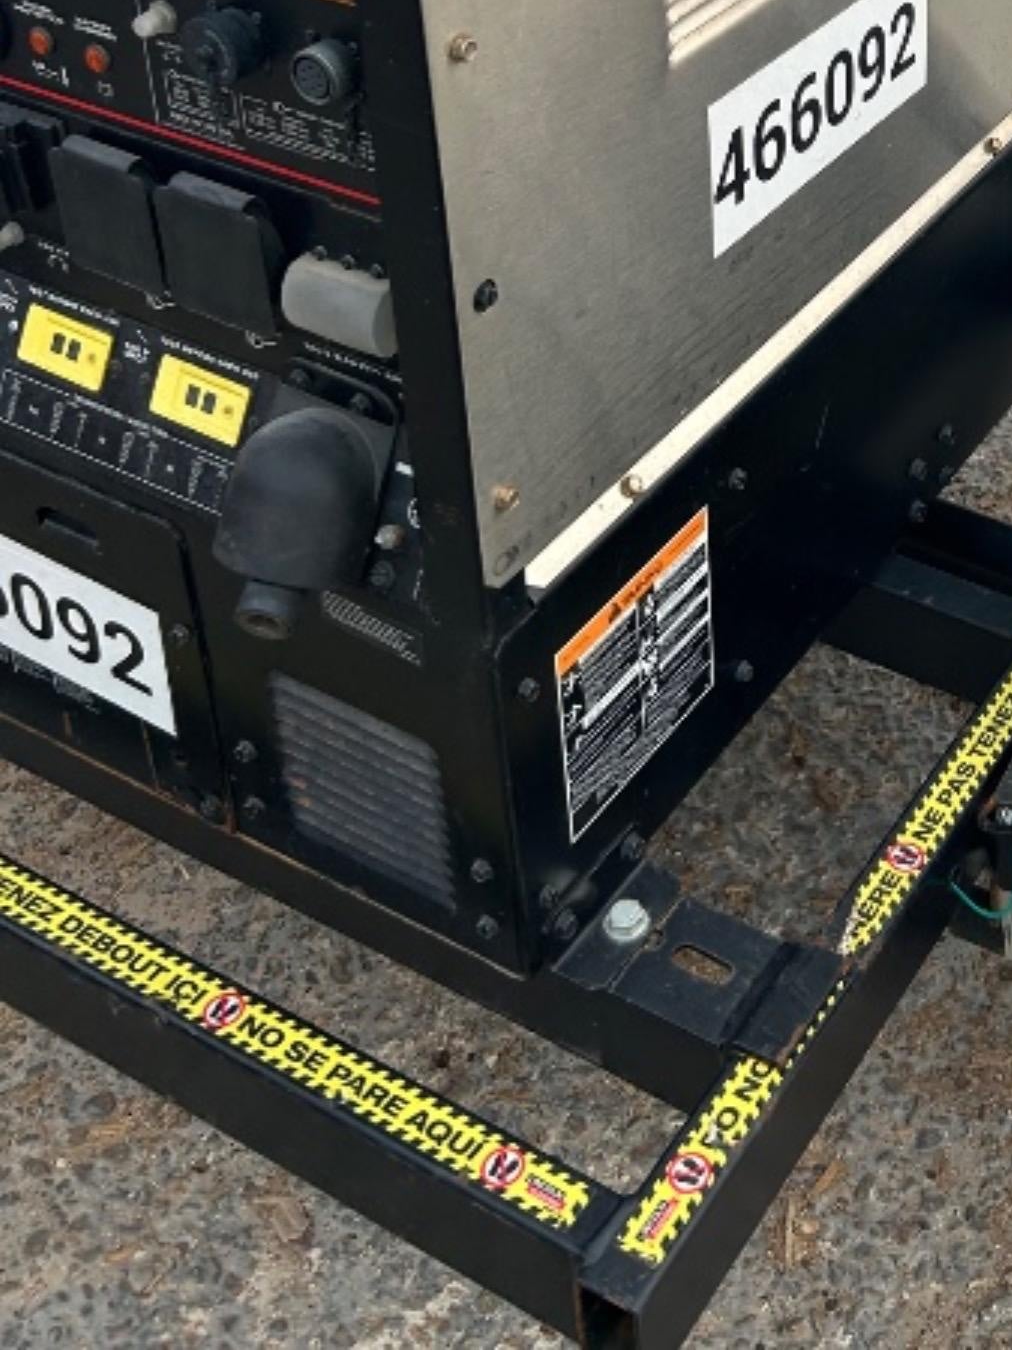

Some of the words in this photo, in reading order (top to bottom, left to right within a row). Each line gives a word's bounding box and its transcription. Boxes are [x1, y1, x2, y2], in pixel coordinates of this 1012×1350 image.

[713, 2, 917, 206] 466092
[912, 809, 946, 843] NE
[936, 760, 977, 807] PAS
[58, 914, 172, 983] DEBOUT
[238, 1015, 286, 1049] NO
[283, 1039, 331, 1073] SE
[325, 1066, 407, 1118] PARE
[404, 1108, 486, 1163] AQUÍ
